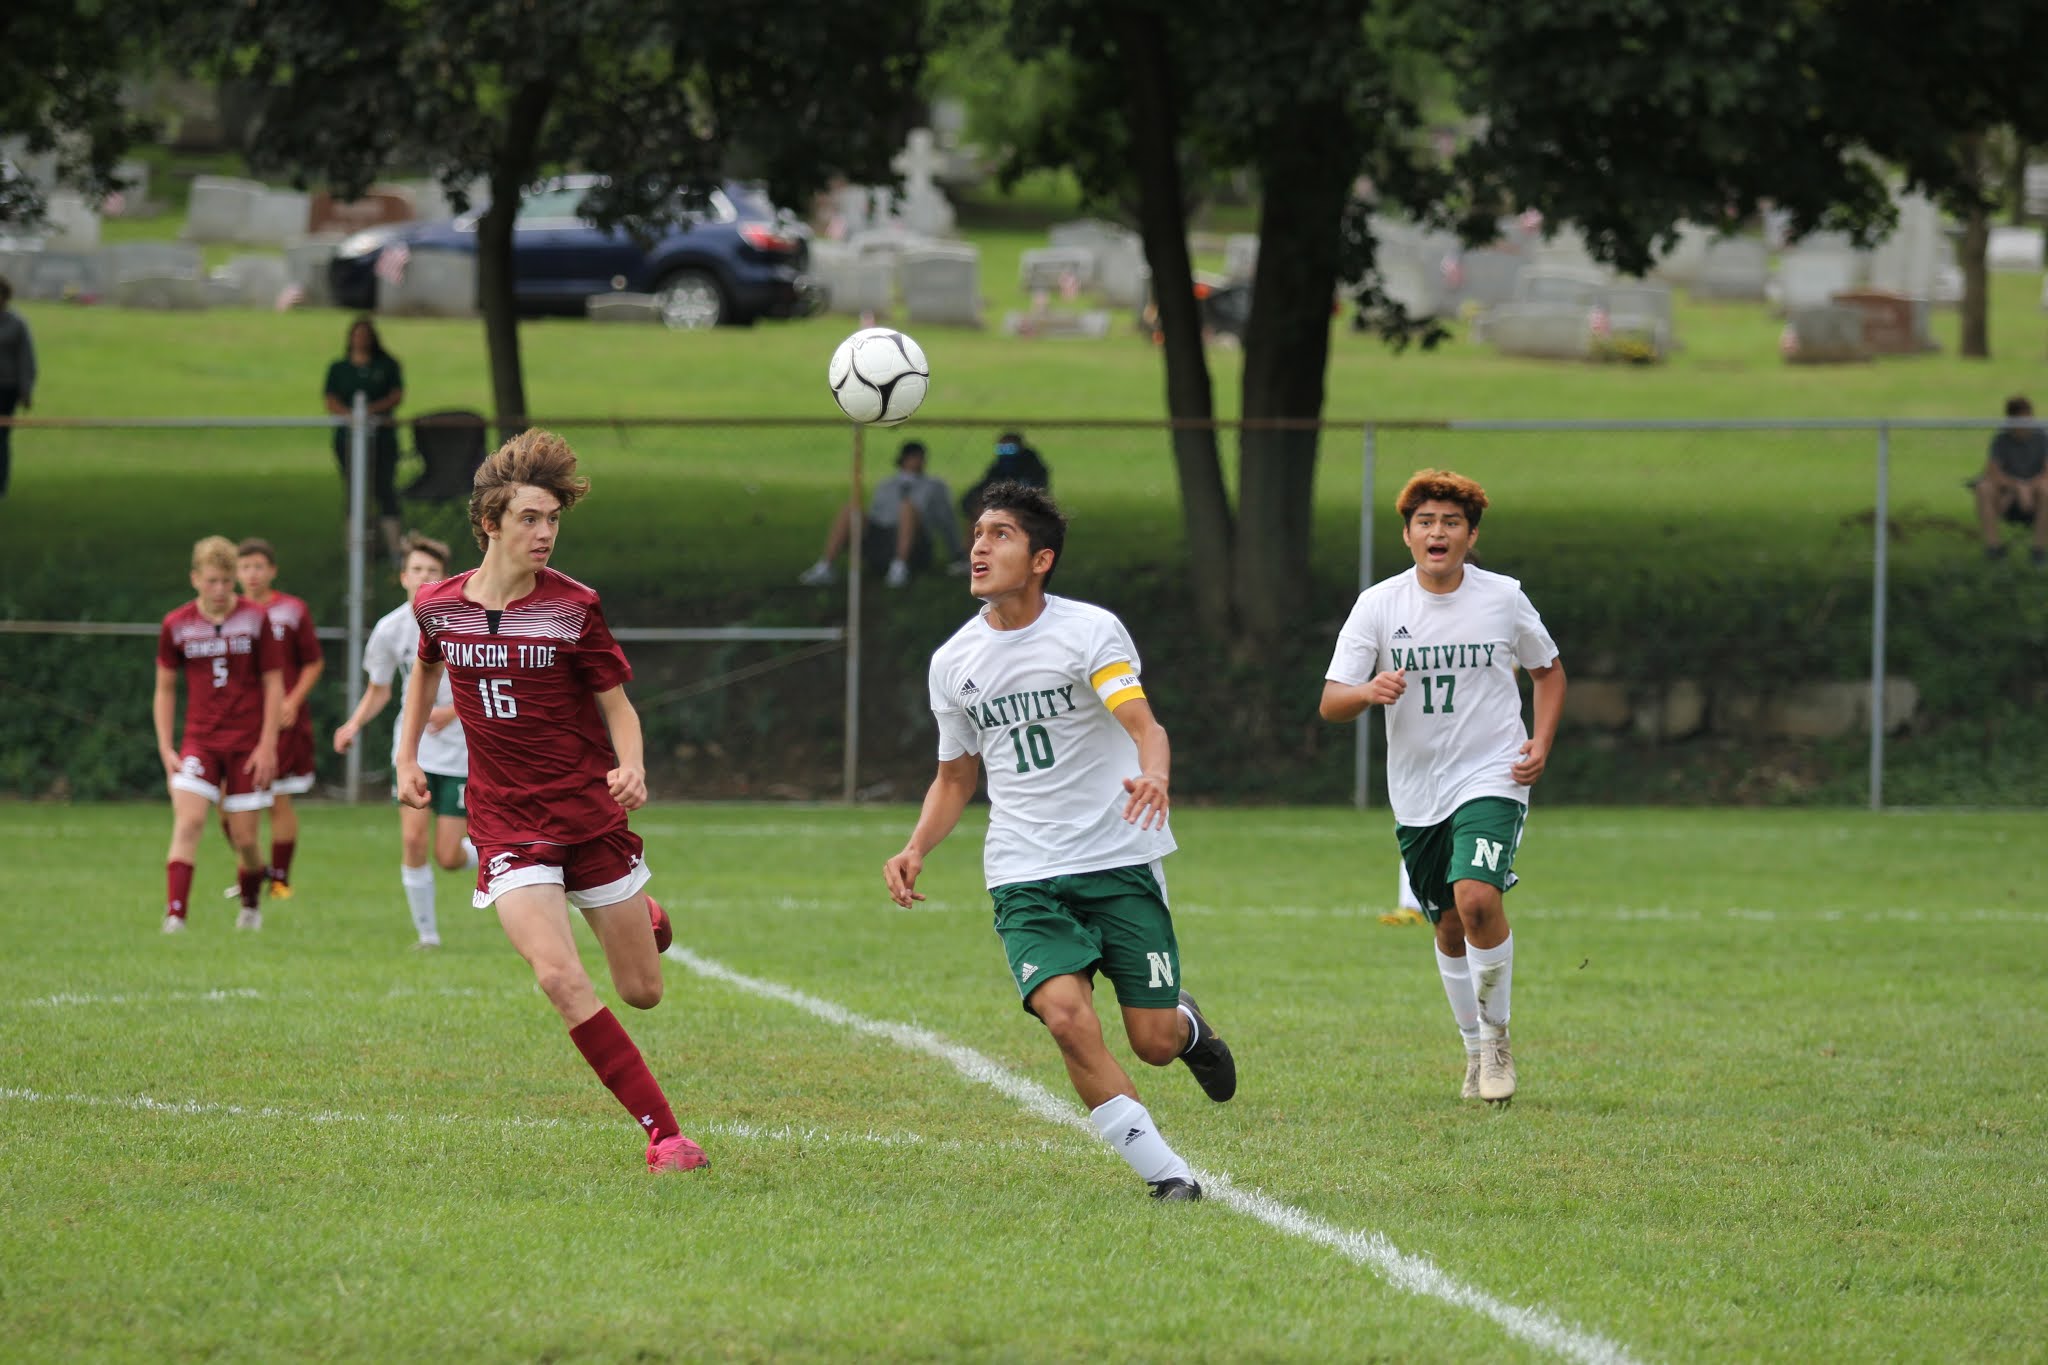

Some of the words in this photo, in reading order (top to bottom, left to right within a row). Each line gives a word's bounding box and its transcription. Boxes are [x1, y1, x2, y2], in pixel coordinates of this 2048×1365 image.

[212, 657, 229, 688] 5
[440, 640, 508, 668] CRIMSON
[518, 644, 557, 669] TIDE
[1391, 644, 1496, 672] NATIVITY
[478, 678, 518, 719] 16
[965, 683, 1077, 731] NATIVITY
[1421, 675, 1456, 714] 17
[1009, 724, 1056, 774] 10
[1471, 837, 1504, 872] N
[1147, 952, 1174, 988] N
